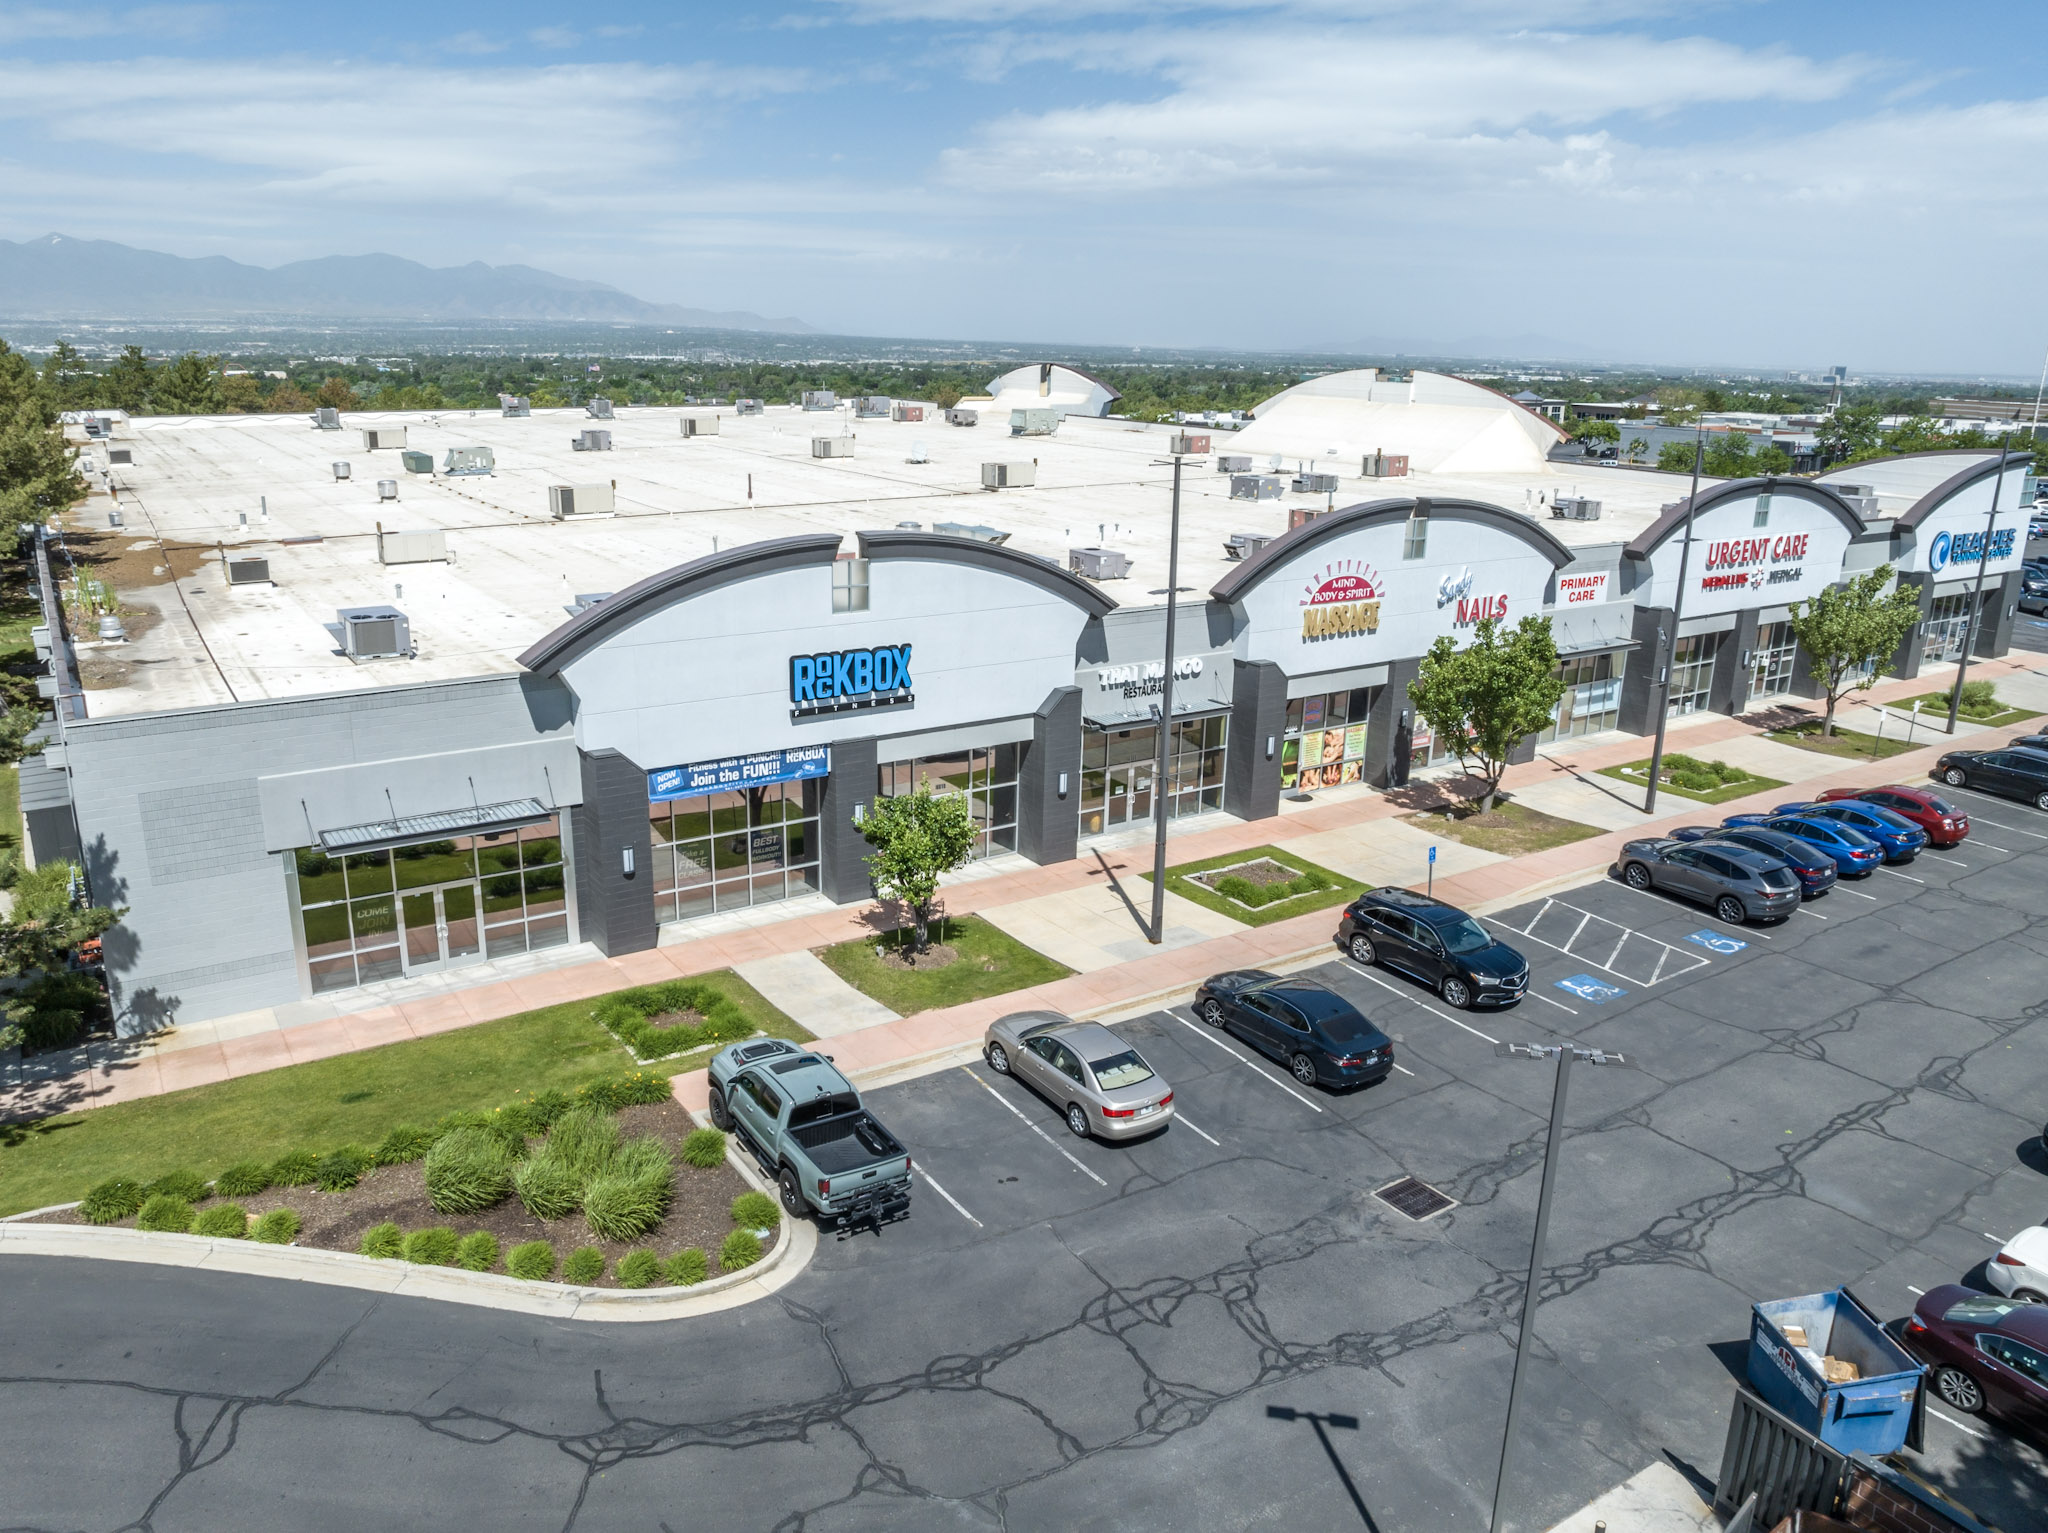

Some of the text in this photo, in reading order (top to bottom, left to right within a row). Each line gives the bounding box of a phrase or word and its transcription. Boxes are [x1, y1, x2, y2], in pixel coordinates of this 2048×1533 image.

[1707, 533, 1809, 566] URGENT CARE
[1952, 547, 2013, 562] TANNING CENTER
[1769, 567, 1803, 580] MEDICAL
[1331, 578, 1357, 589] MIND
[1437, 565, 1474, 603] Sandy
[1560, 575, 1606, 591] PRIMARY
[1314, 587, 1372, 602] BODY & SPIRIT
[1568, 589, 1596, 603] CARE
[1456, 594, 1508, 623] NAILS
[1302, 601, 1381, 637] MASSAGE
[1099, 665, 1138, 685] THAI
[1123, 682, 1165, 699] RESTAURA
[795, 695, 912, 717] FITNESS
[688, 762, 718, 773] Fitness
[719, 757, 738, 769] with
[746, 751, 781, 764] PUNCH!!
[657, 769, 677, 783] NOW
[690, 772, 716, 787] Join
[719, 768, 739, 781] the
[743, 761, 780, 779] FUN!!!
[657, 778, 681, 792] OPEN!
[753, 835, 779, 848] BEST
[752, 845, 780, 855] FULLBODY
[679, 856, 708, 870] FREE
[357, 905, 389, 918] COME
[359, 915, 390, 930] JOIN
